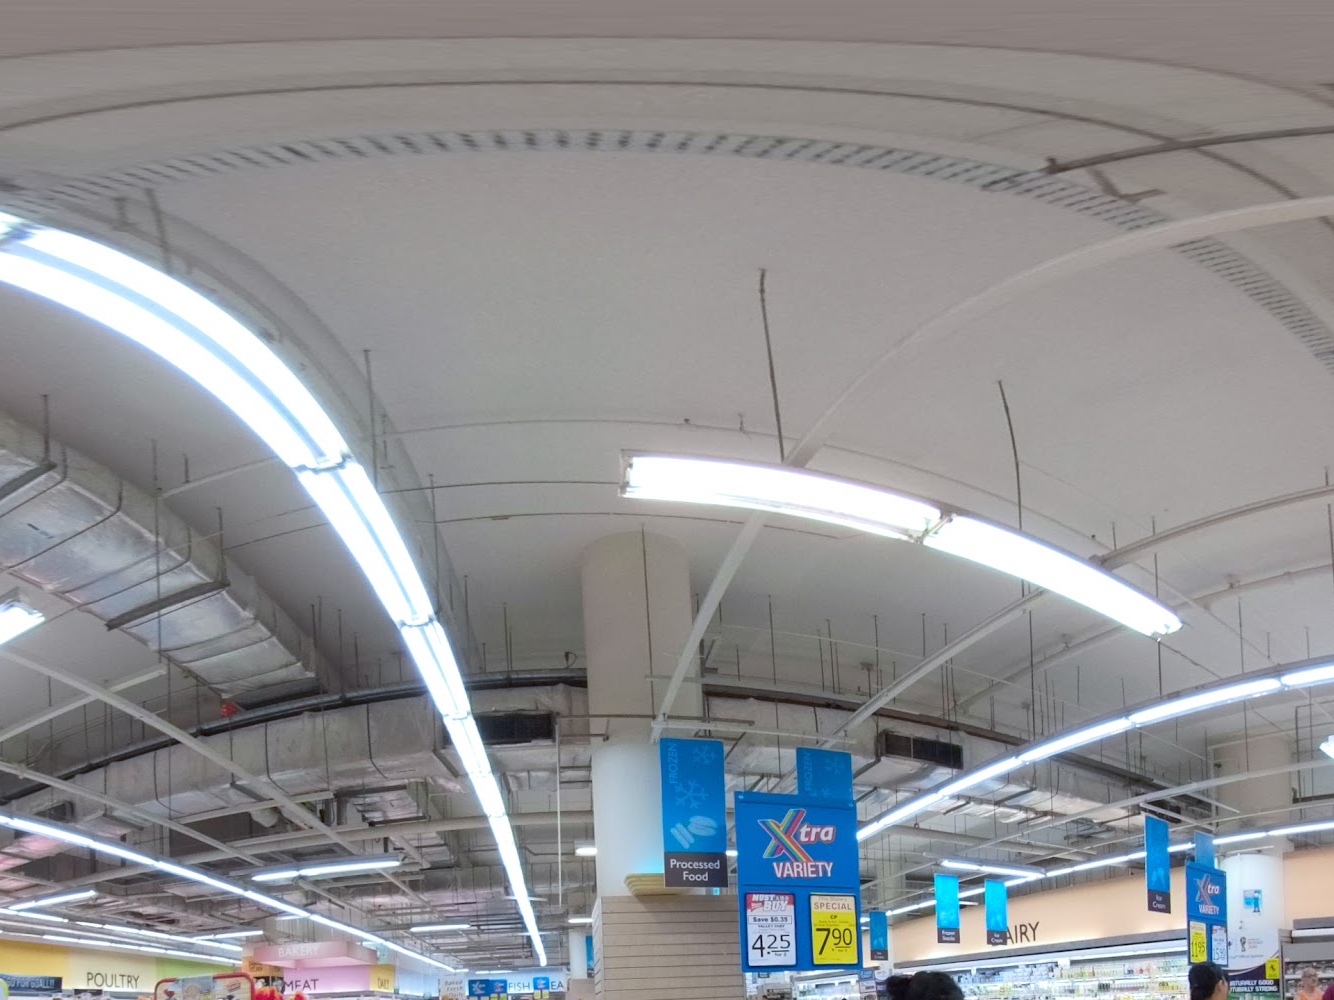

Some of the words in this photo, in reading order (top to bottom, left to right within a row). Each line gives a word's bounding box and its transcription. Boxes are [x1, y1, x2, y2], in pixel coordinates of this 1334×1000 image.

[667, 743, 679, 783] FROZEN
[804, 752, 813, 792] FROZEN
[757, 808, 836, 863] Xtra
[670, 858, 721, 870] Processed
[773, 862, 834, 878] VARIETY
[683, 871, 709, 882] Food
[763, 901, 789, 911] BUY
[813, 902, 852, 910] SPECIAL
[1005, 921, 1040, 944] AIRY
[278, 945, 318, 958] BAKERY
[752, 934, 791, 958] 4.25
[86, 972, 140, 989] POULTRY
[377, 977, 389, 989] DAILY
[508, 982, 530, 991] FISH
